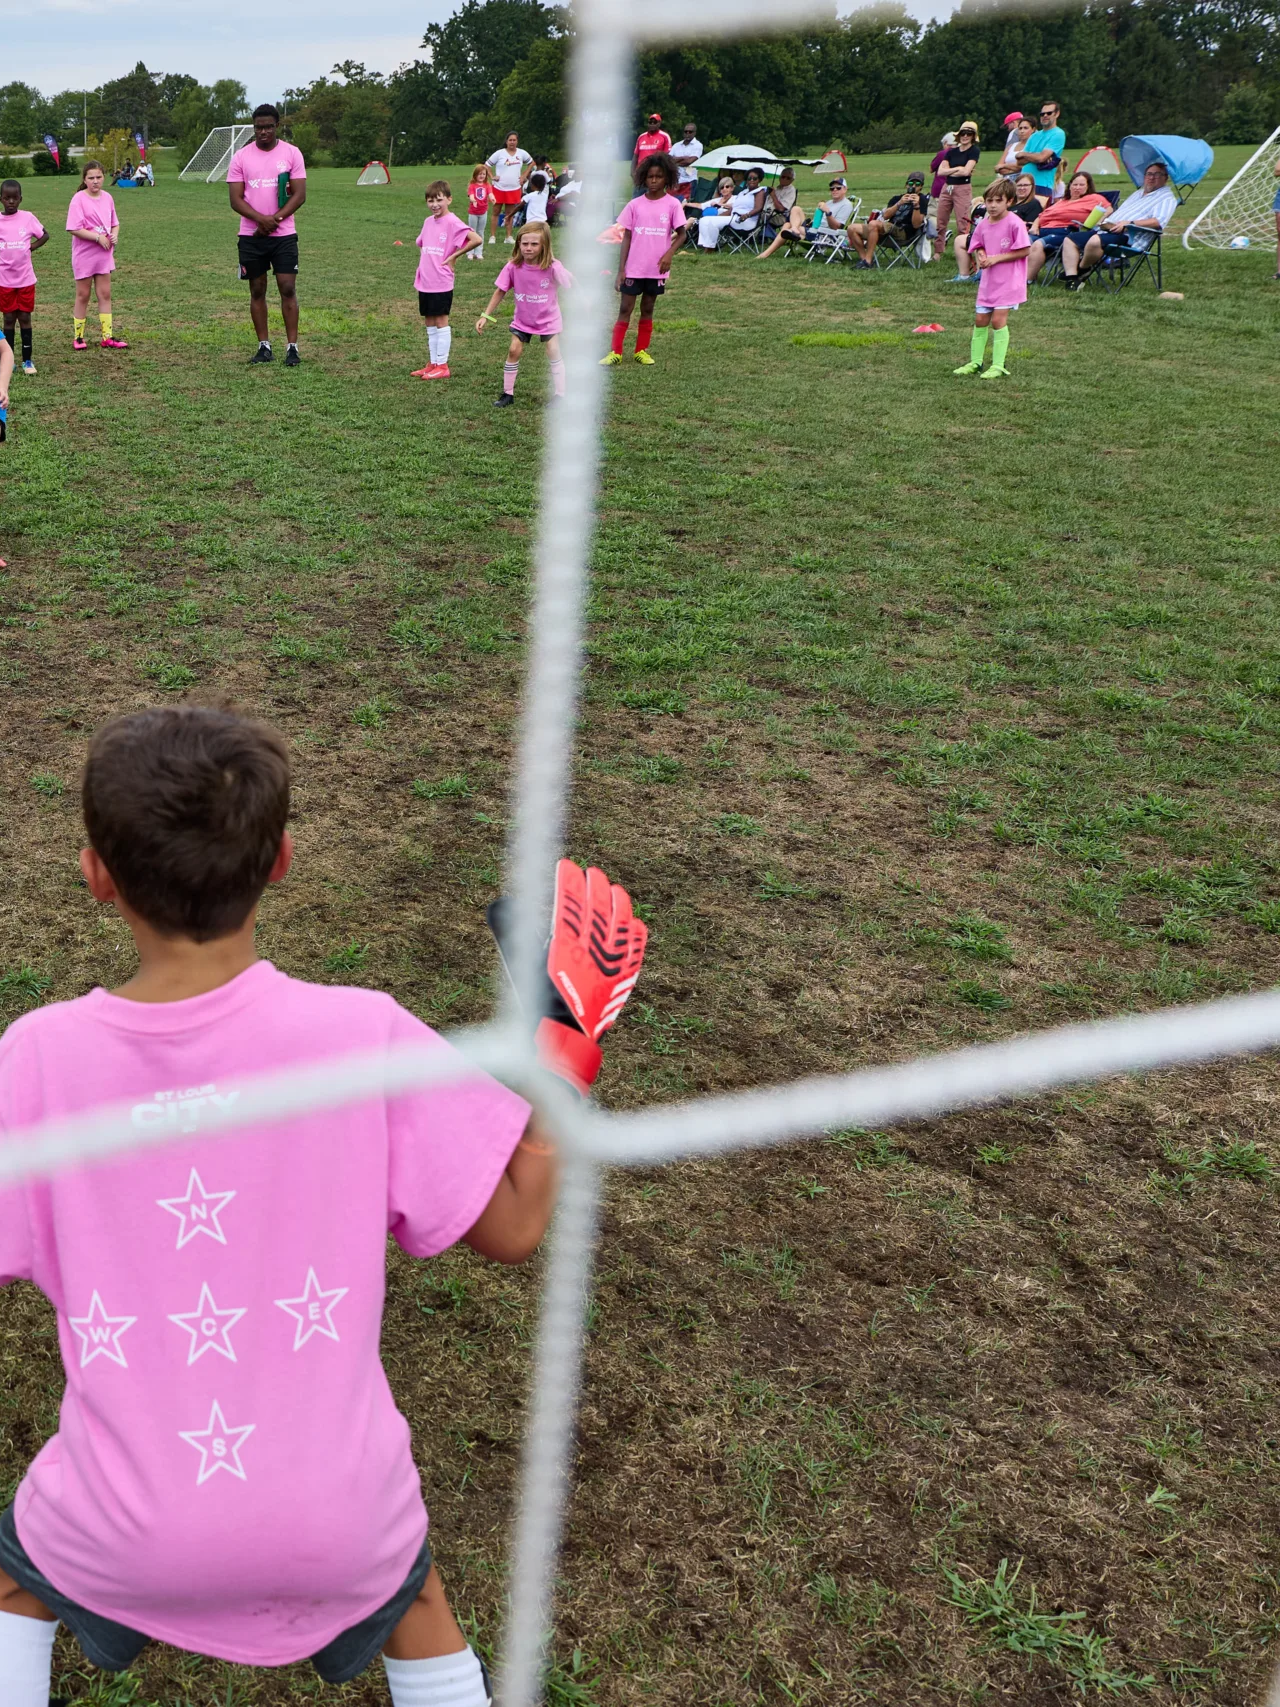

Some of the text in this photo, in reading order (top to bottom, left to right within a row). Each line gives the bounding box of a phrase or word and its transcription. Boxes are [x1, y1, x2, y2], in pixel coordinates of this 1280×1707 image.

[557, 970, 585, 1018] PREDATOR
[131, 1091, 241, 1129] CITY
[190, 1202, 208, 1221] N
[308, 1302, 321, 1320] E
[88, 1326, 111, 1343] W
[200, 1318, 217, 1336] C
[212, 1438, 228, 1457] S
